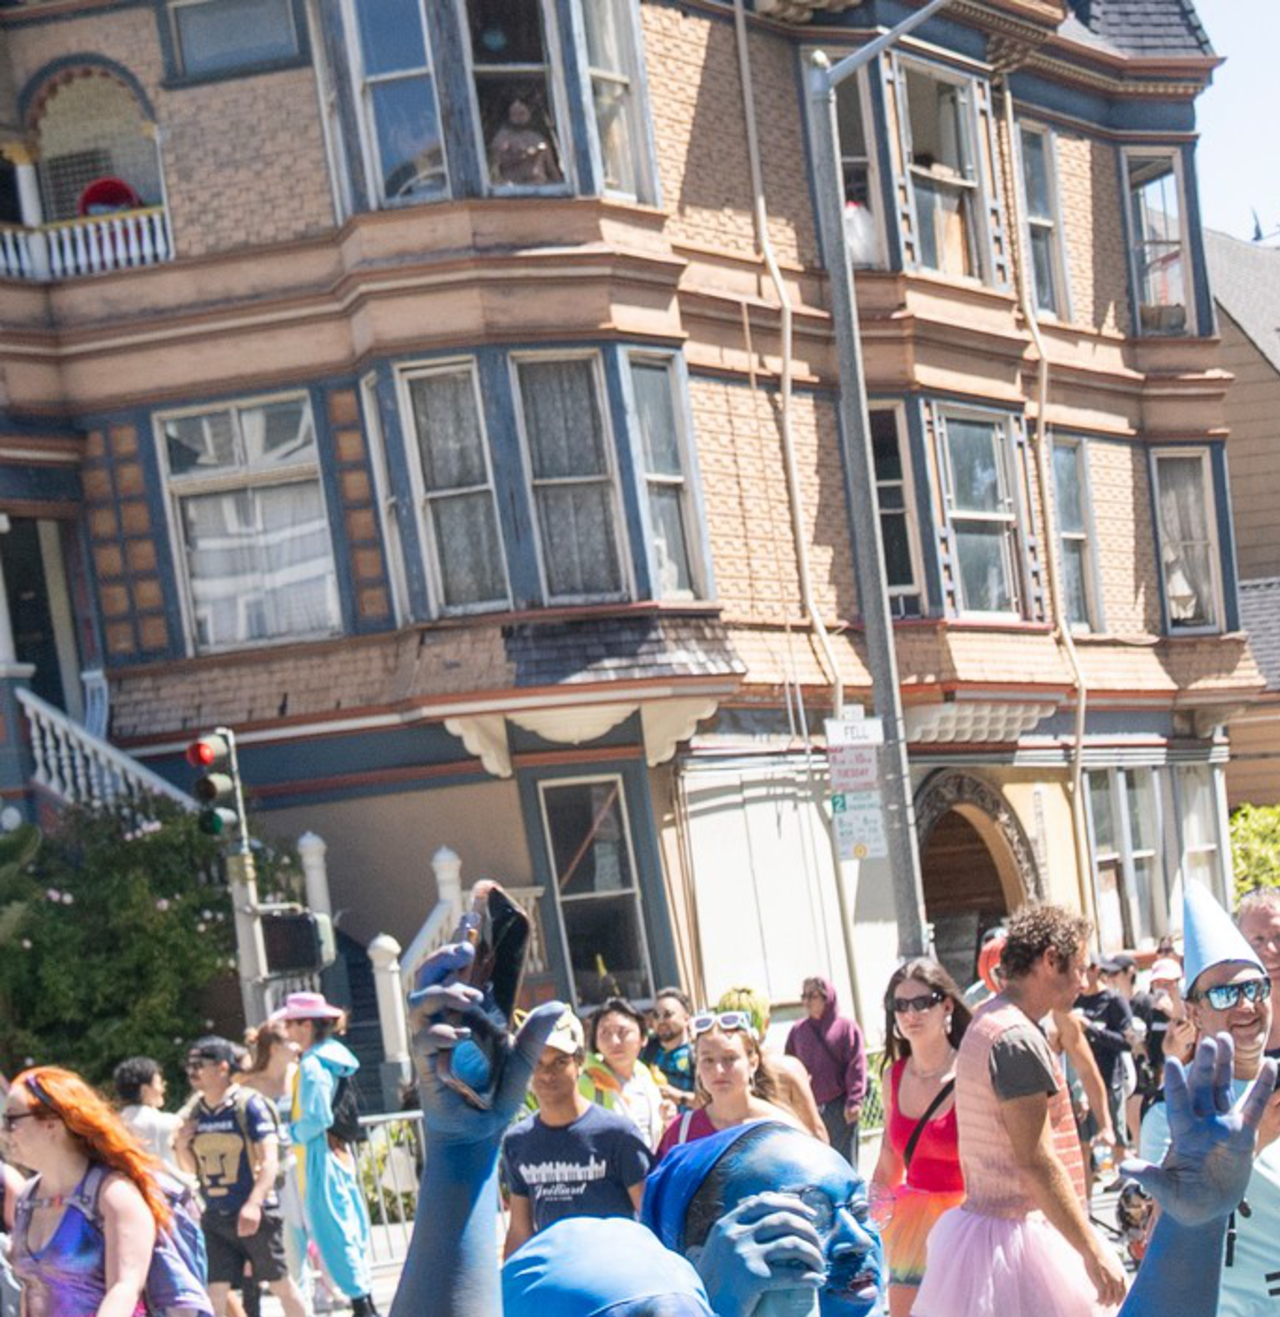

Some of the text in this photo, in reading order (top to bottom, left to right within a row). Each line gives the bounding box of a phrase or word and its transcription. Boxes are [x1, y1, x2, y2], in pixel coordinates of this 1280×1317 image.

[844, 725, 869, 740] FELL
[833, 795, 844, 812] 2
[535, 1181, 587, 1199] Juilliard
